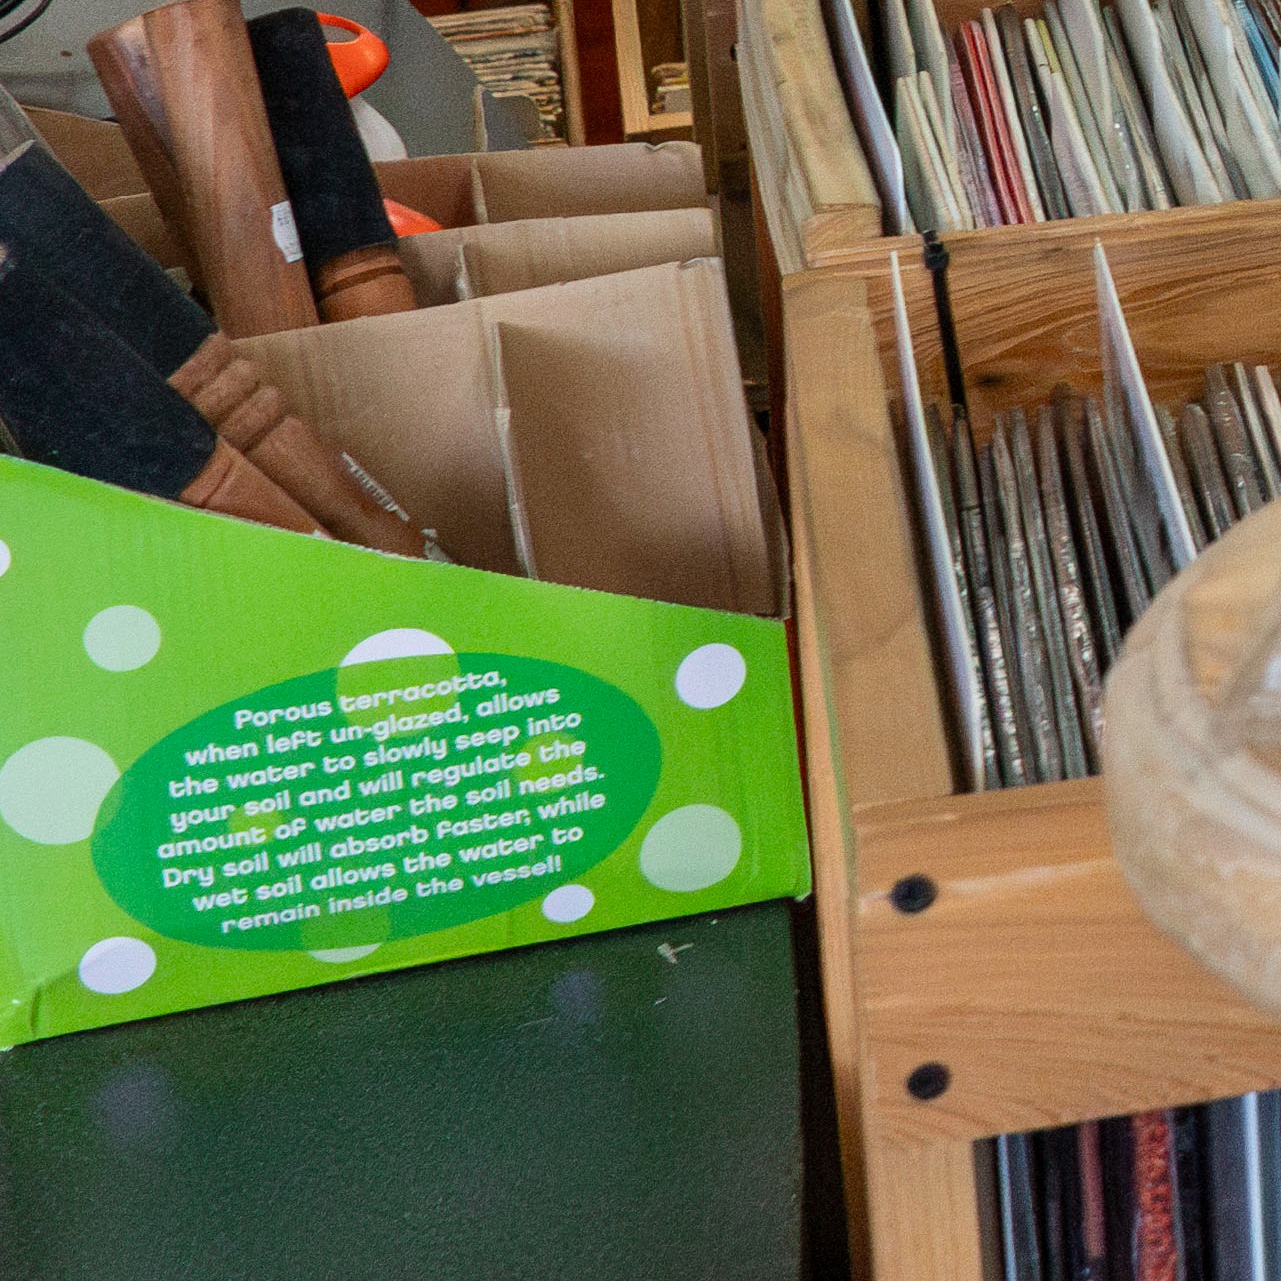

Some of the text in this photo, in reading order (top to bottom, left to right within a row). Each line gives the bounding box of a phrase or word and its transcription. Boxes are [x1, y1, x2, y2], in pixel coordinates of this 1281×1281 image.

[185, 687, 561, 767] when left un-glazed, allows
[234, 670, 507, 730] Porous terracotta,
[168, 711, 582, 799] the water to slowly seep into
[169, 739, 587, 834] your soil and will regulate the
[157, 764, 606, 859] amount of water the soil needs.
[162, 865, 215, 889] Dry
[222, 851, 270, 878] soil
[276, 841, 322, 869] will
[329, 824, 430, 859] absorb
[536, 790, 607, 821] while
[192, 826, 584, 913] wet soil allows the water to
[221, 853, 562, 935] remain inside the vessel!
